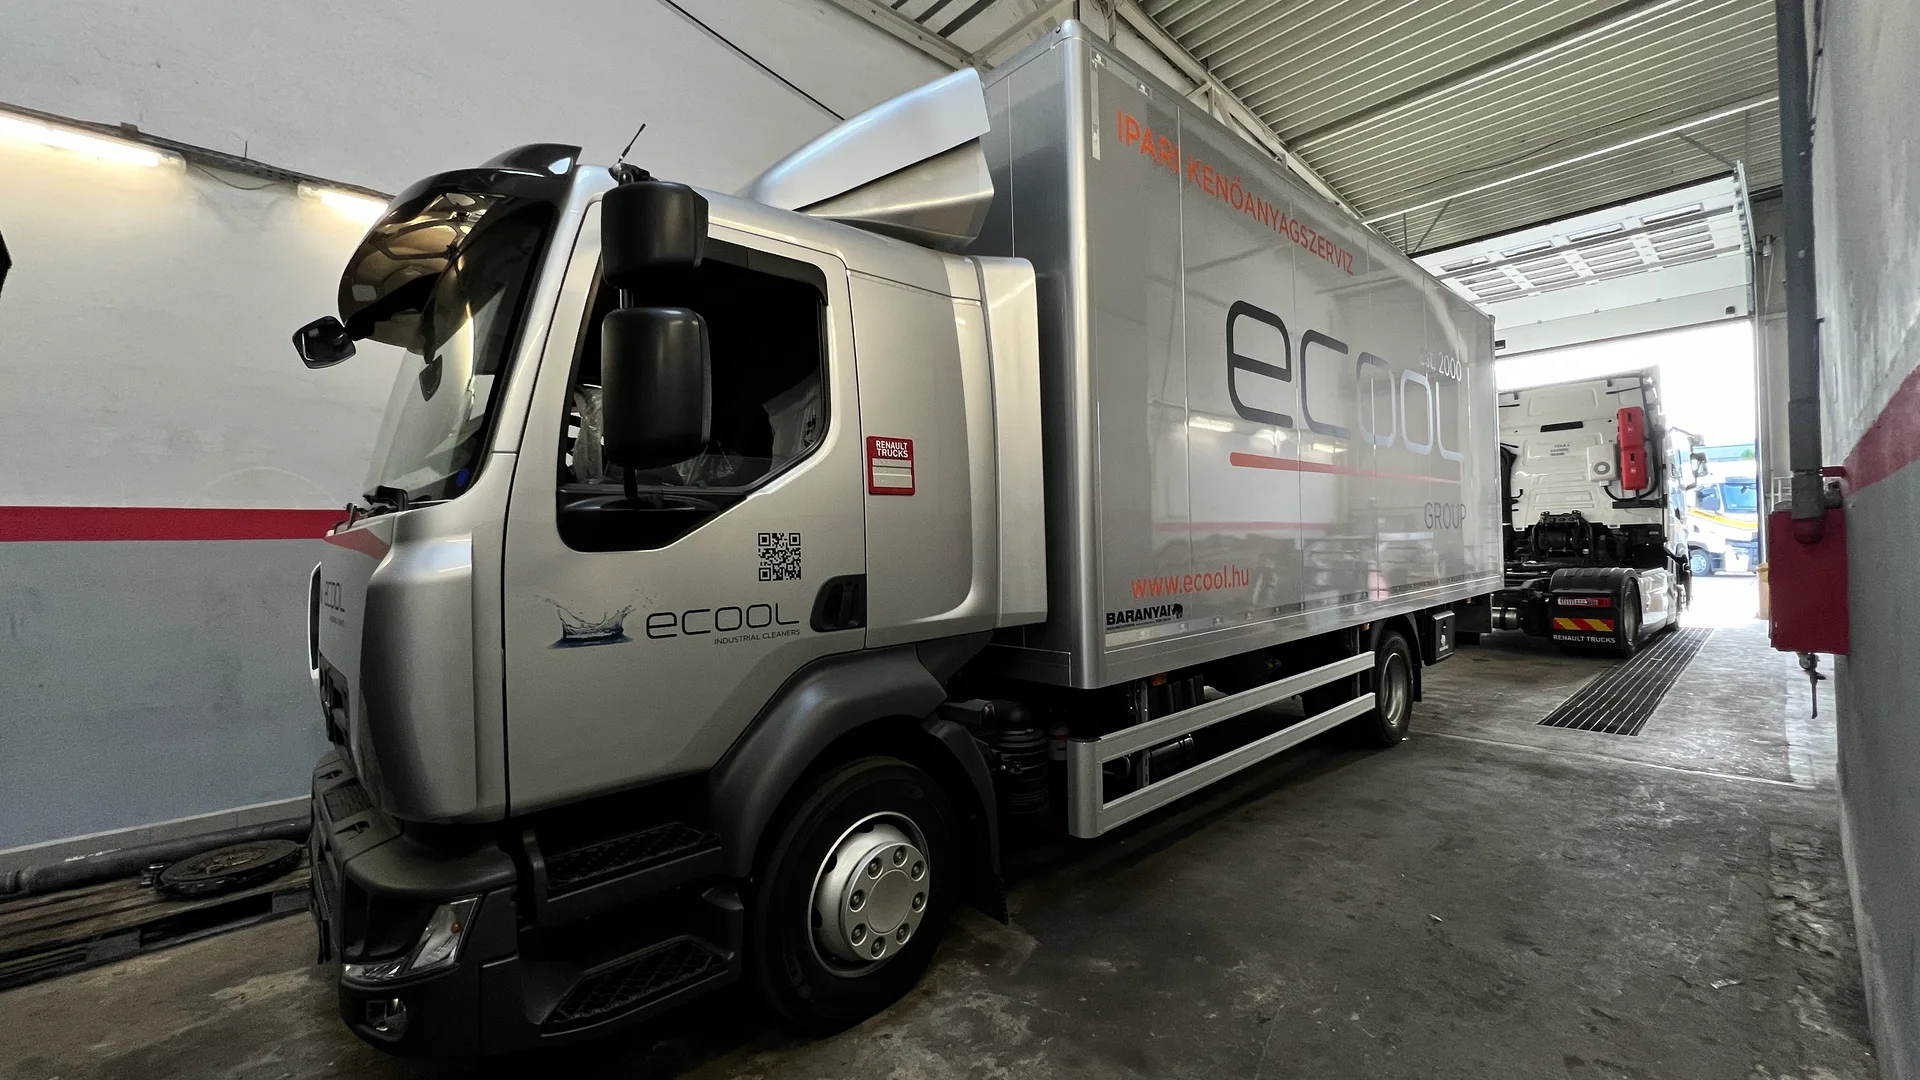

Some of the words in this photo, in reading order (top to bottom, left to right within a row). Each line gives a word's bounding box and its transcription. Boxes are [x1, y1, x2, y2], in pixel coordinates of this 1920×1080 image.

[1116, 109, 1180, 176] IPARI
[1187, 154, 1354, 276] KENŐANYAGSZERVIZ
[1438, 351, 1462, 382] 2000
[875, 440, 908, 450] RENAULT
[876, 448, 909, 458] TRUCKS
[1424, 501, 1467, 530] GROUP
[1130, 564, 1250, 599] www.ecool.hu
[1106, 604, 1172, 626] BARANYAI
[714, 633, 760, 646] INDUSTRIAL
[762, 628, 801, 640] CLEANERS
[1552, 634, 1585, 642] RENAULT
